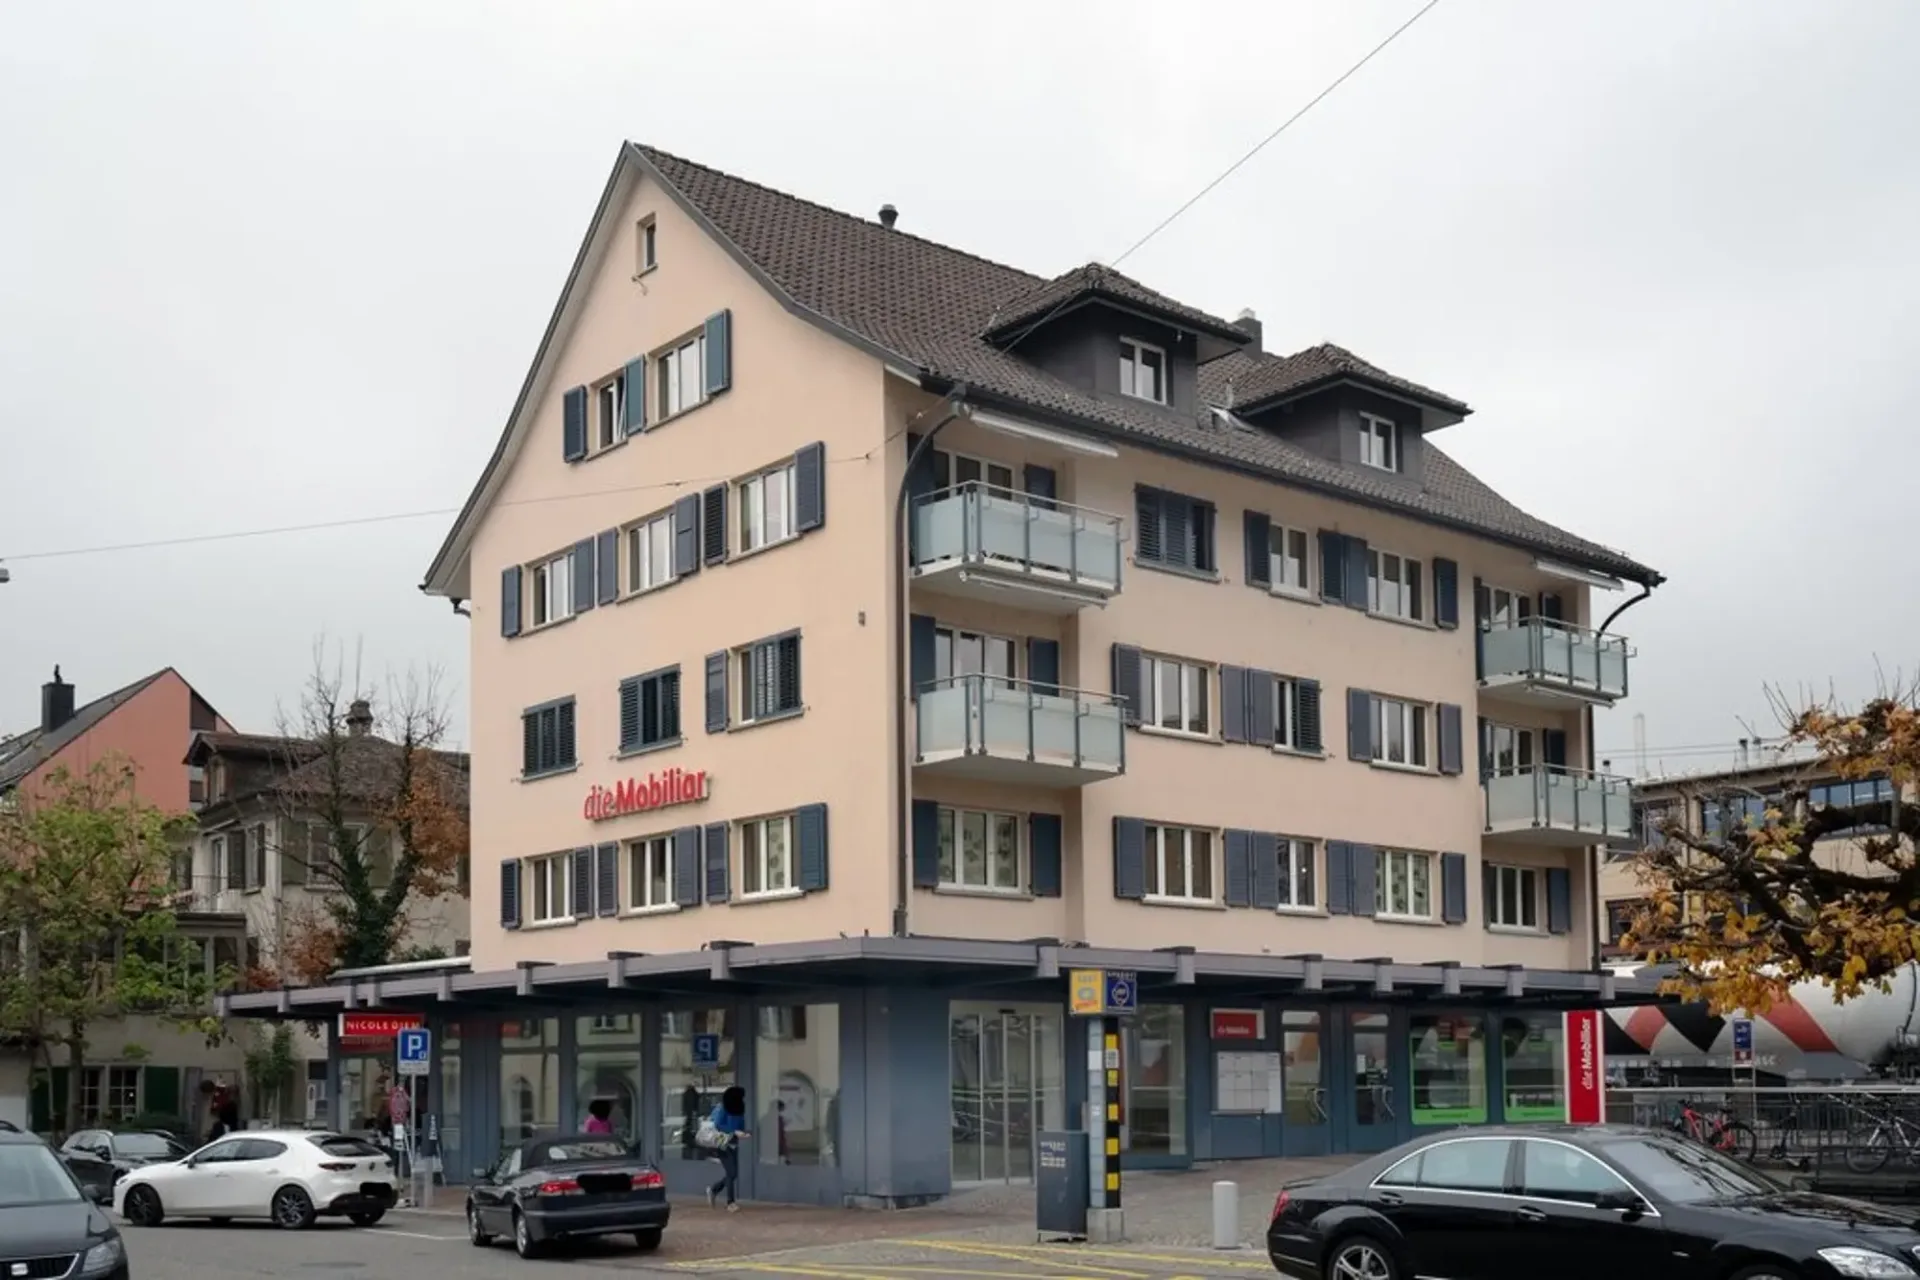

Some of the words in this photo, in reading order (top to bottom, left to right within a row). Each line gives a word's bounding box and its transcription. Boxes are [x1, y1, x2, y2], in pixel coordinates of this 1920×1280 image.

[616, 768, 706, 812] Mobiliar
[346, 1020, 388, 1030] NICOLE
[408, 1035, 422, 1057] P
